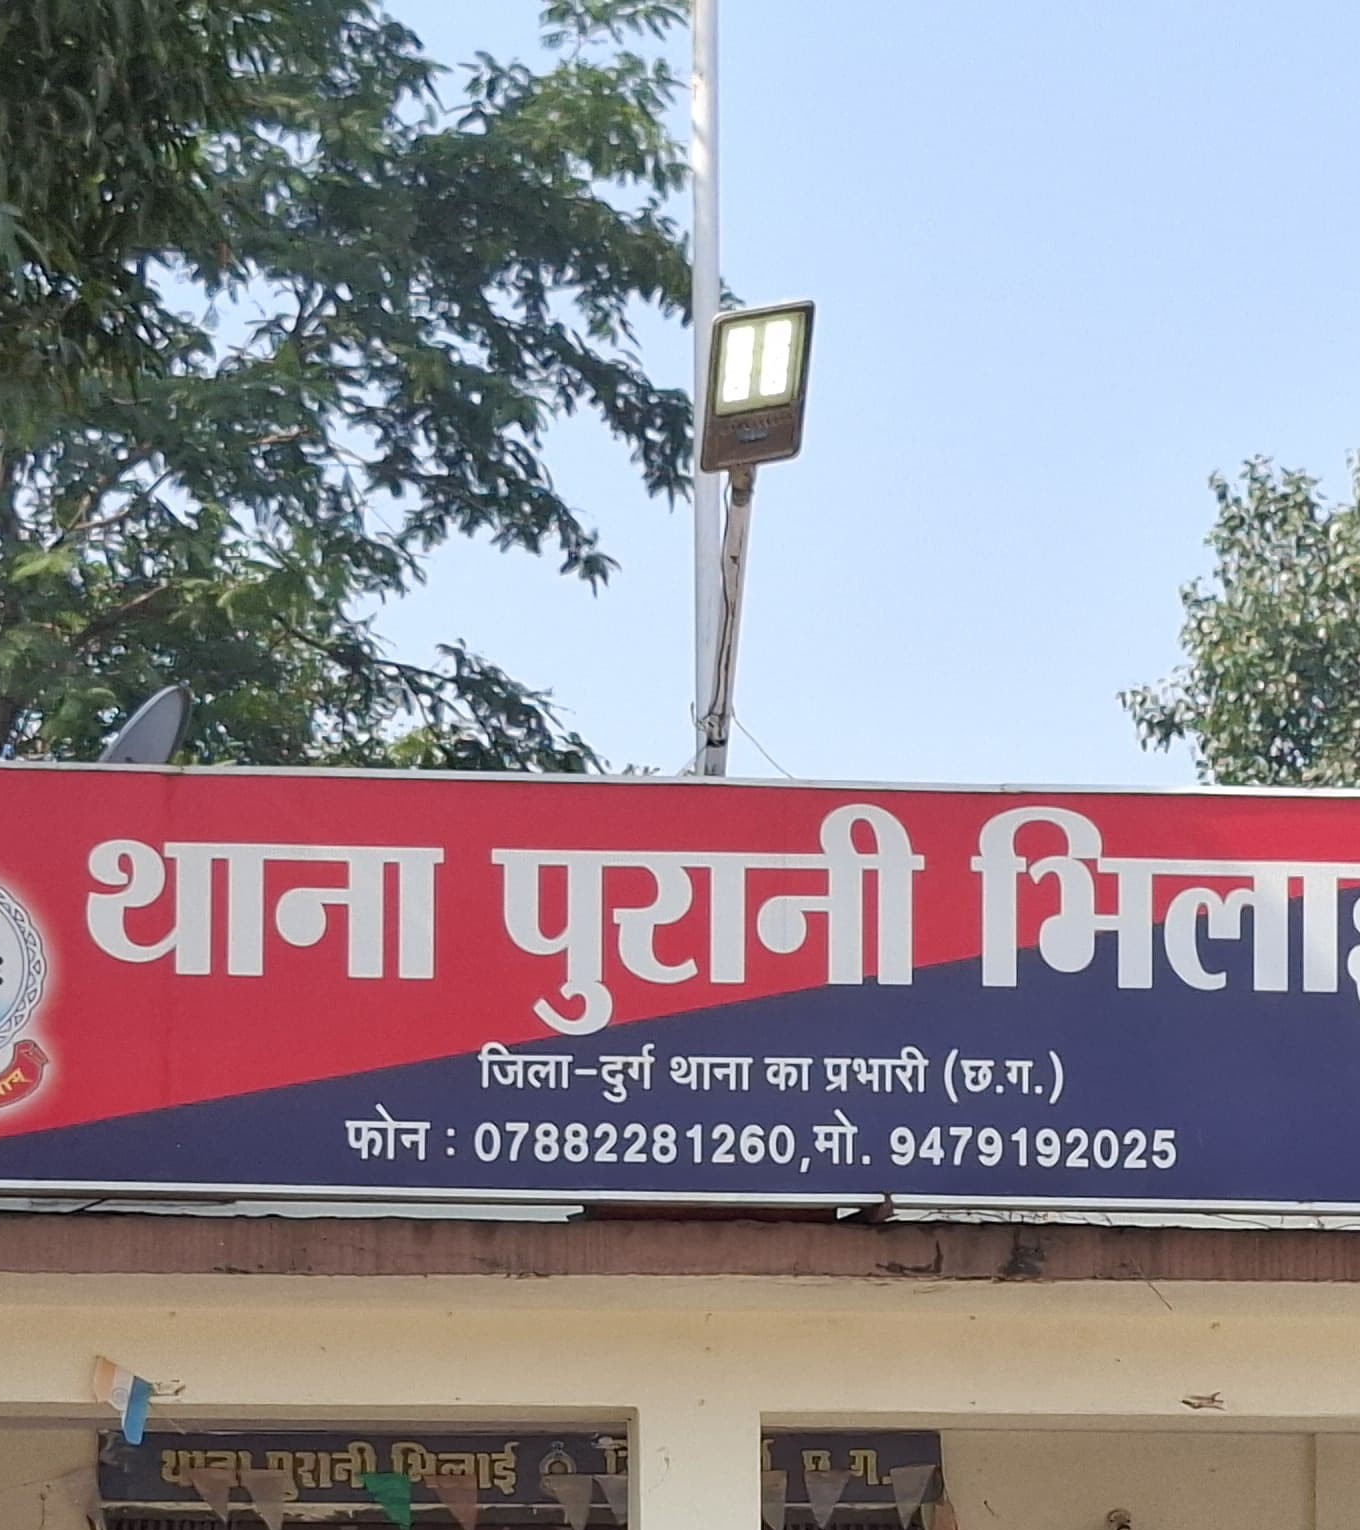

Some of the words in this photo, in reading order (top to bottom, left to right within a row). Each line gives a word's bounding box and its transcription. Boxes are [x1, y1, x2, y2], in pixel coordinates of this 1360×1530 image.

[85, 838, 444, 980] थाना
[491, 803, 925, 1036] पुरानी
[669, 1055, 753, 1091] थाना
[763, 1056, 813, 1092] का
[823, 1045, 929, 1094] प्रभारी
[943, 1048, 1064, 1104] (छ.ग.)
[344, 1103, 431, 1161] फोन
[889, 1126, 1178, 1169] 9479192025
